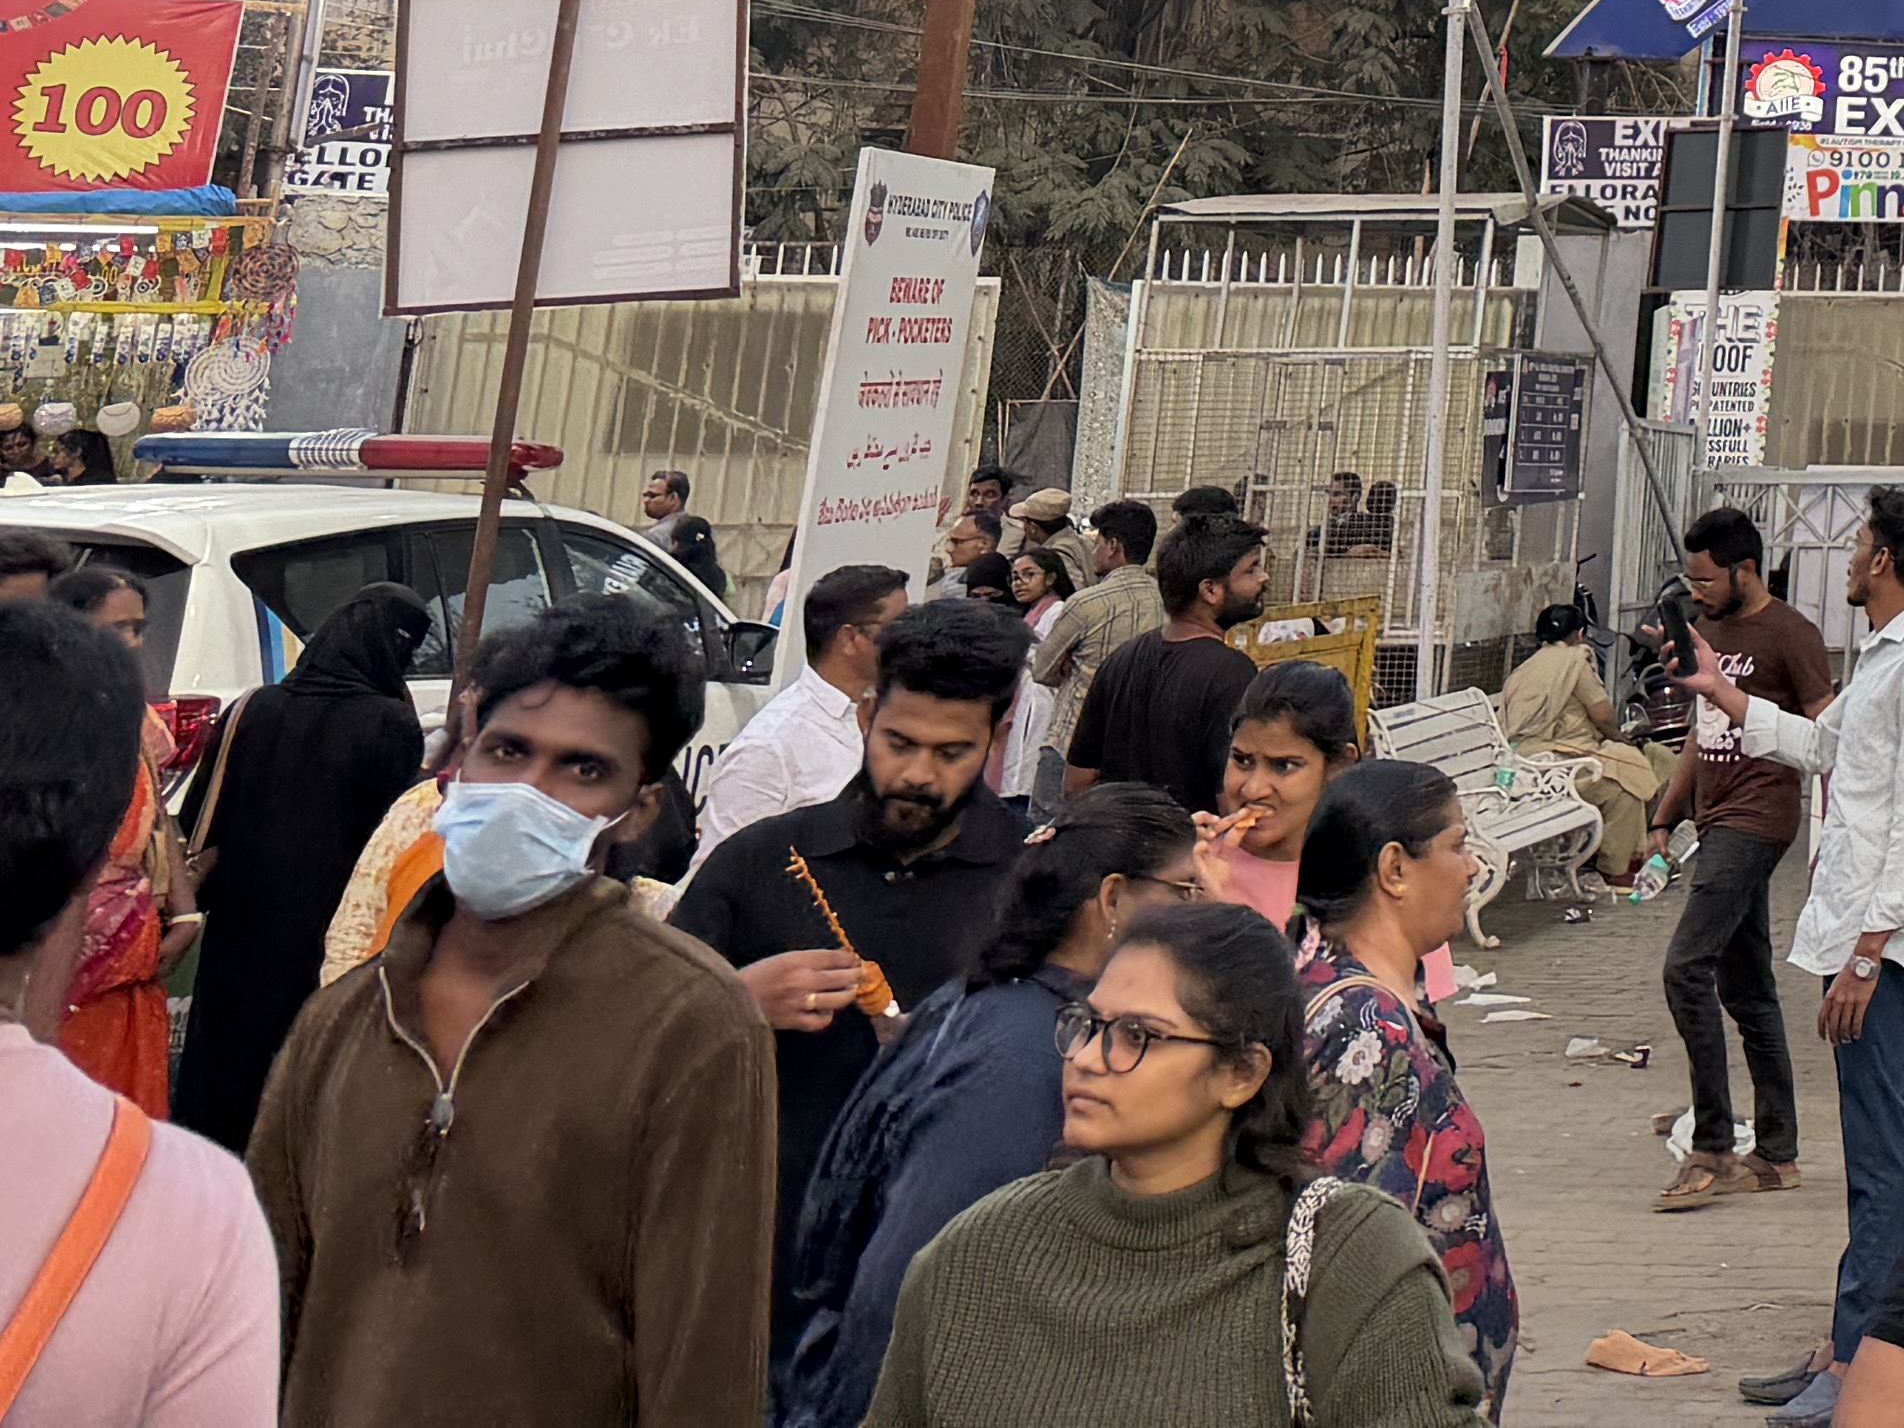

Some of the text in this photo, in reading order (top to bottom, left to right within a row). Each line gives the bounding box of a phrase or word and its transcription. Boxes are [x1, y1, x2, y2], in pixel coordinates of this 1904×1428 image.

[33, 82, 168, 142] 100
[1766, 96, 1800, 116] AIIE
[1615, 120, 1672, 147] EXI
[1604, 162, 1649, 177] VISIT
[1829, 151, 1891, 168] 9100
[887, 194, 973, 222] HYDERABAD CITY POLICE
[889, 276, 945, 305] BEWARE OF
[866, 317, 893, 344] PICK
[897, 317, 953, 344] POCKETERS
